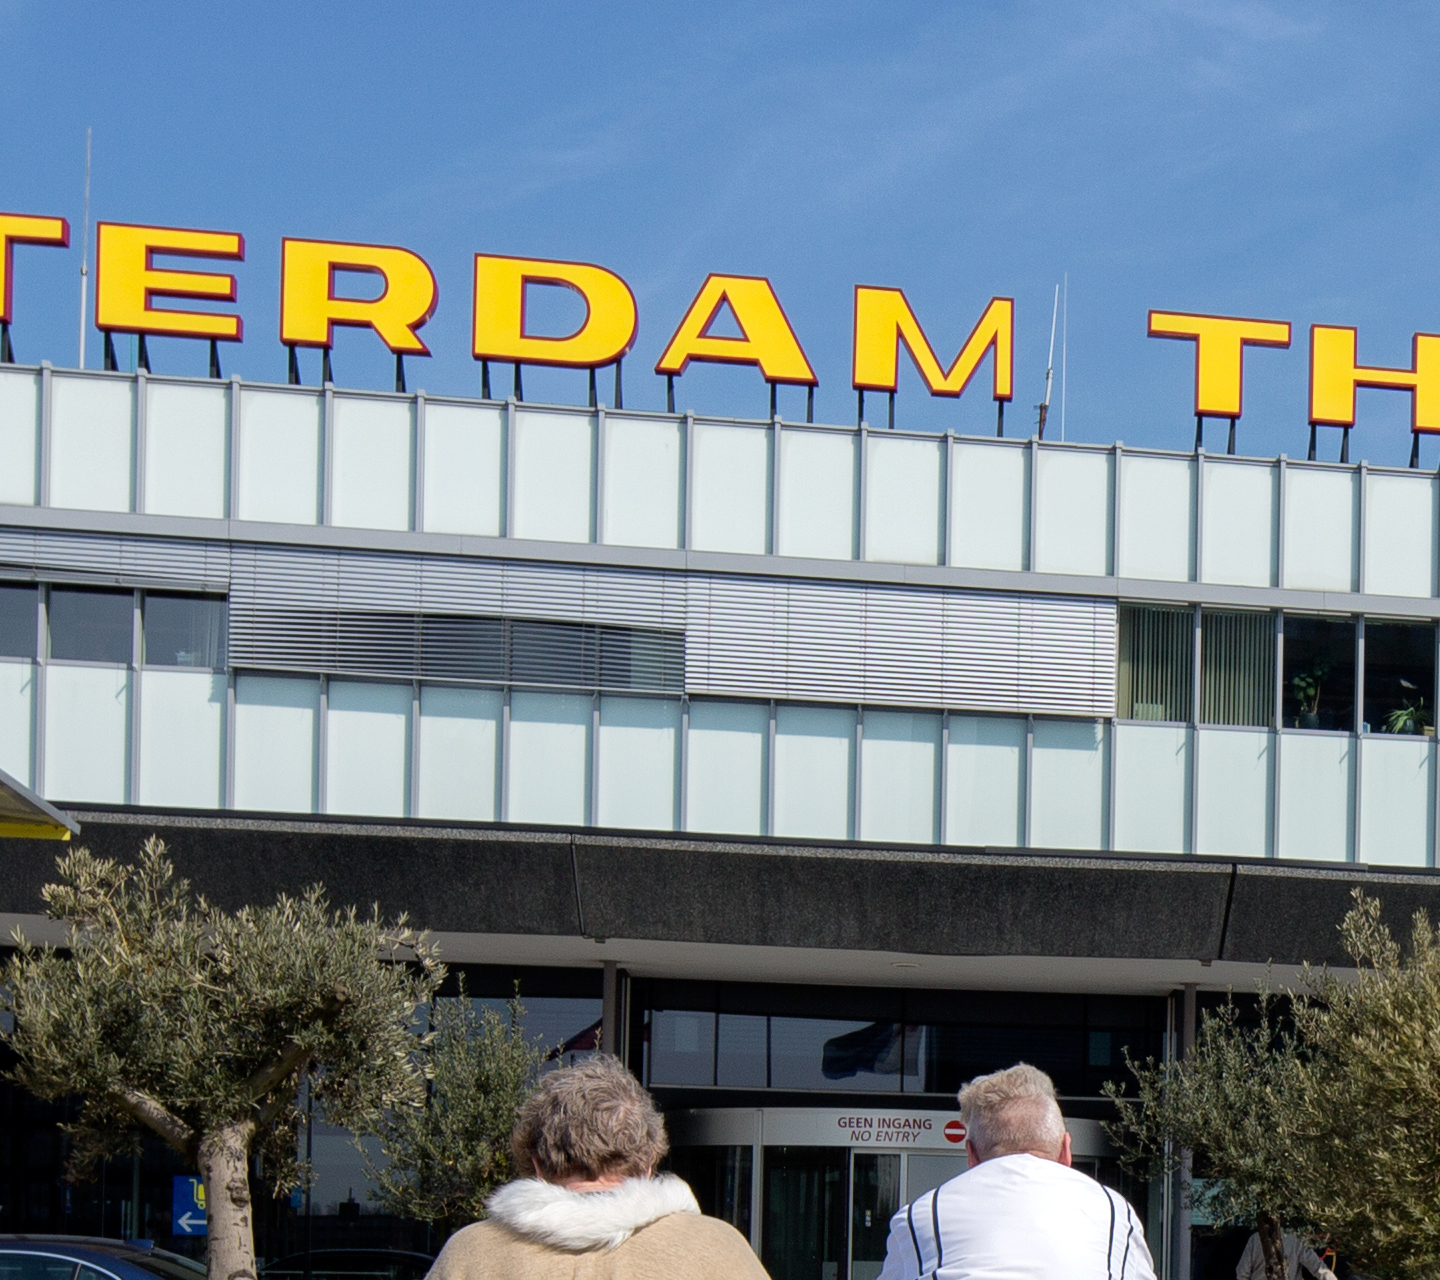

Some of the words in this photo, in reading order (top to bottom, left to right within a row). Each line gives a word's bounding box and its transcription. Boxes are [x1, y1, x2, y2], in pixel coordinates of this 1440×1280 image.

[837, 1117, 873, 1128] GEEN
[877, 1118, 933, 1130] INGANG
[849, 1130, 872, 1141] NO
[875, 1131, 921, 1142] ENTRY
